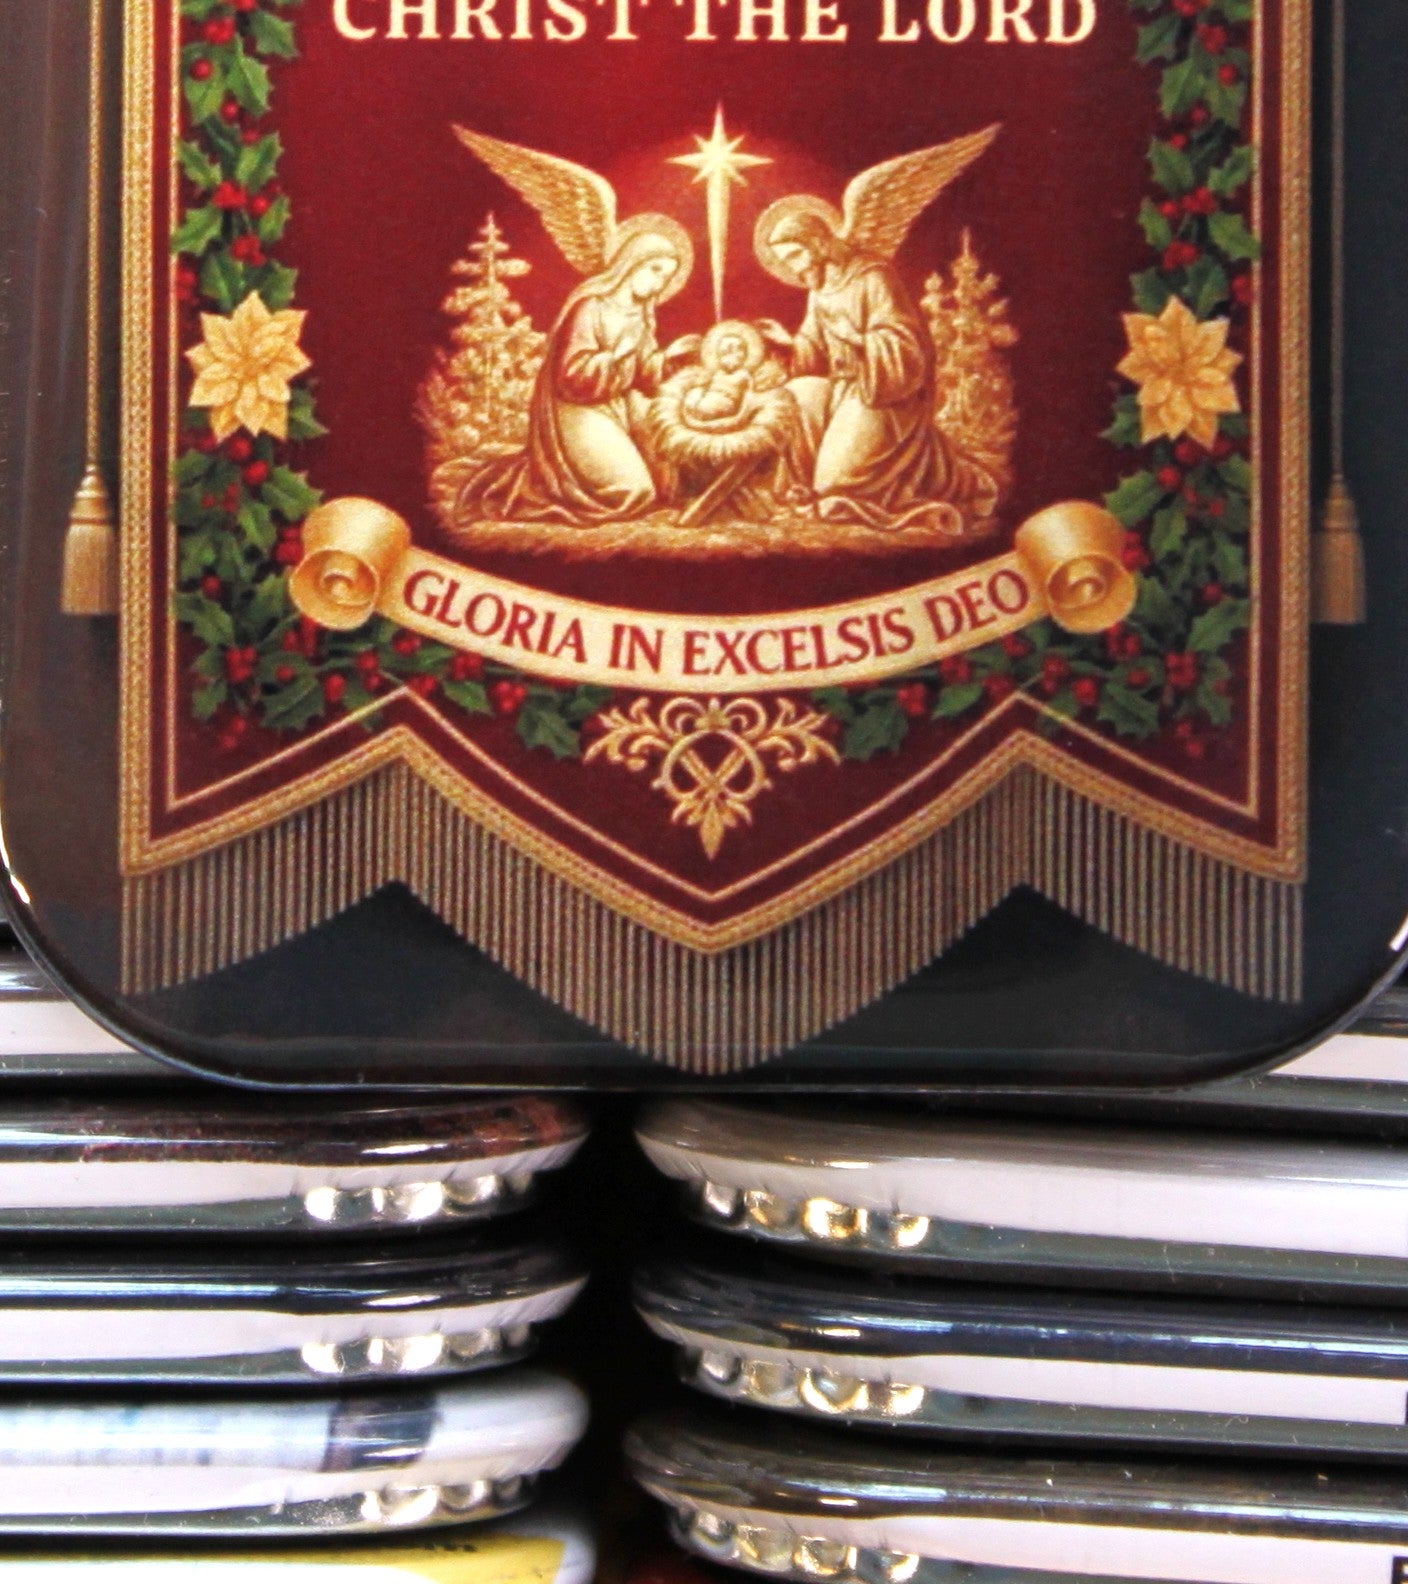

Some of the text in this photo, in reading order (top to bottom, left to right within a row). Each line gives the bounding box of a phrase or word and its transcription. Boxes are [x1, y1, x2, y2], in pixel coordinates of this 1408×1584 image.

[403, 568, 1029, 676] GLORIA IN EXCELSIS DEO
